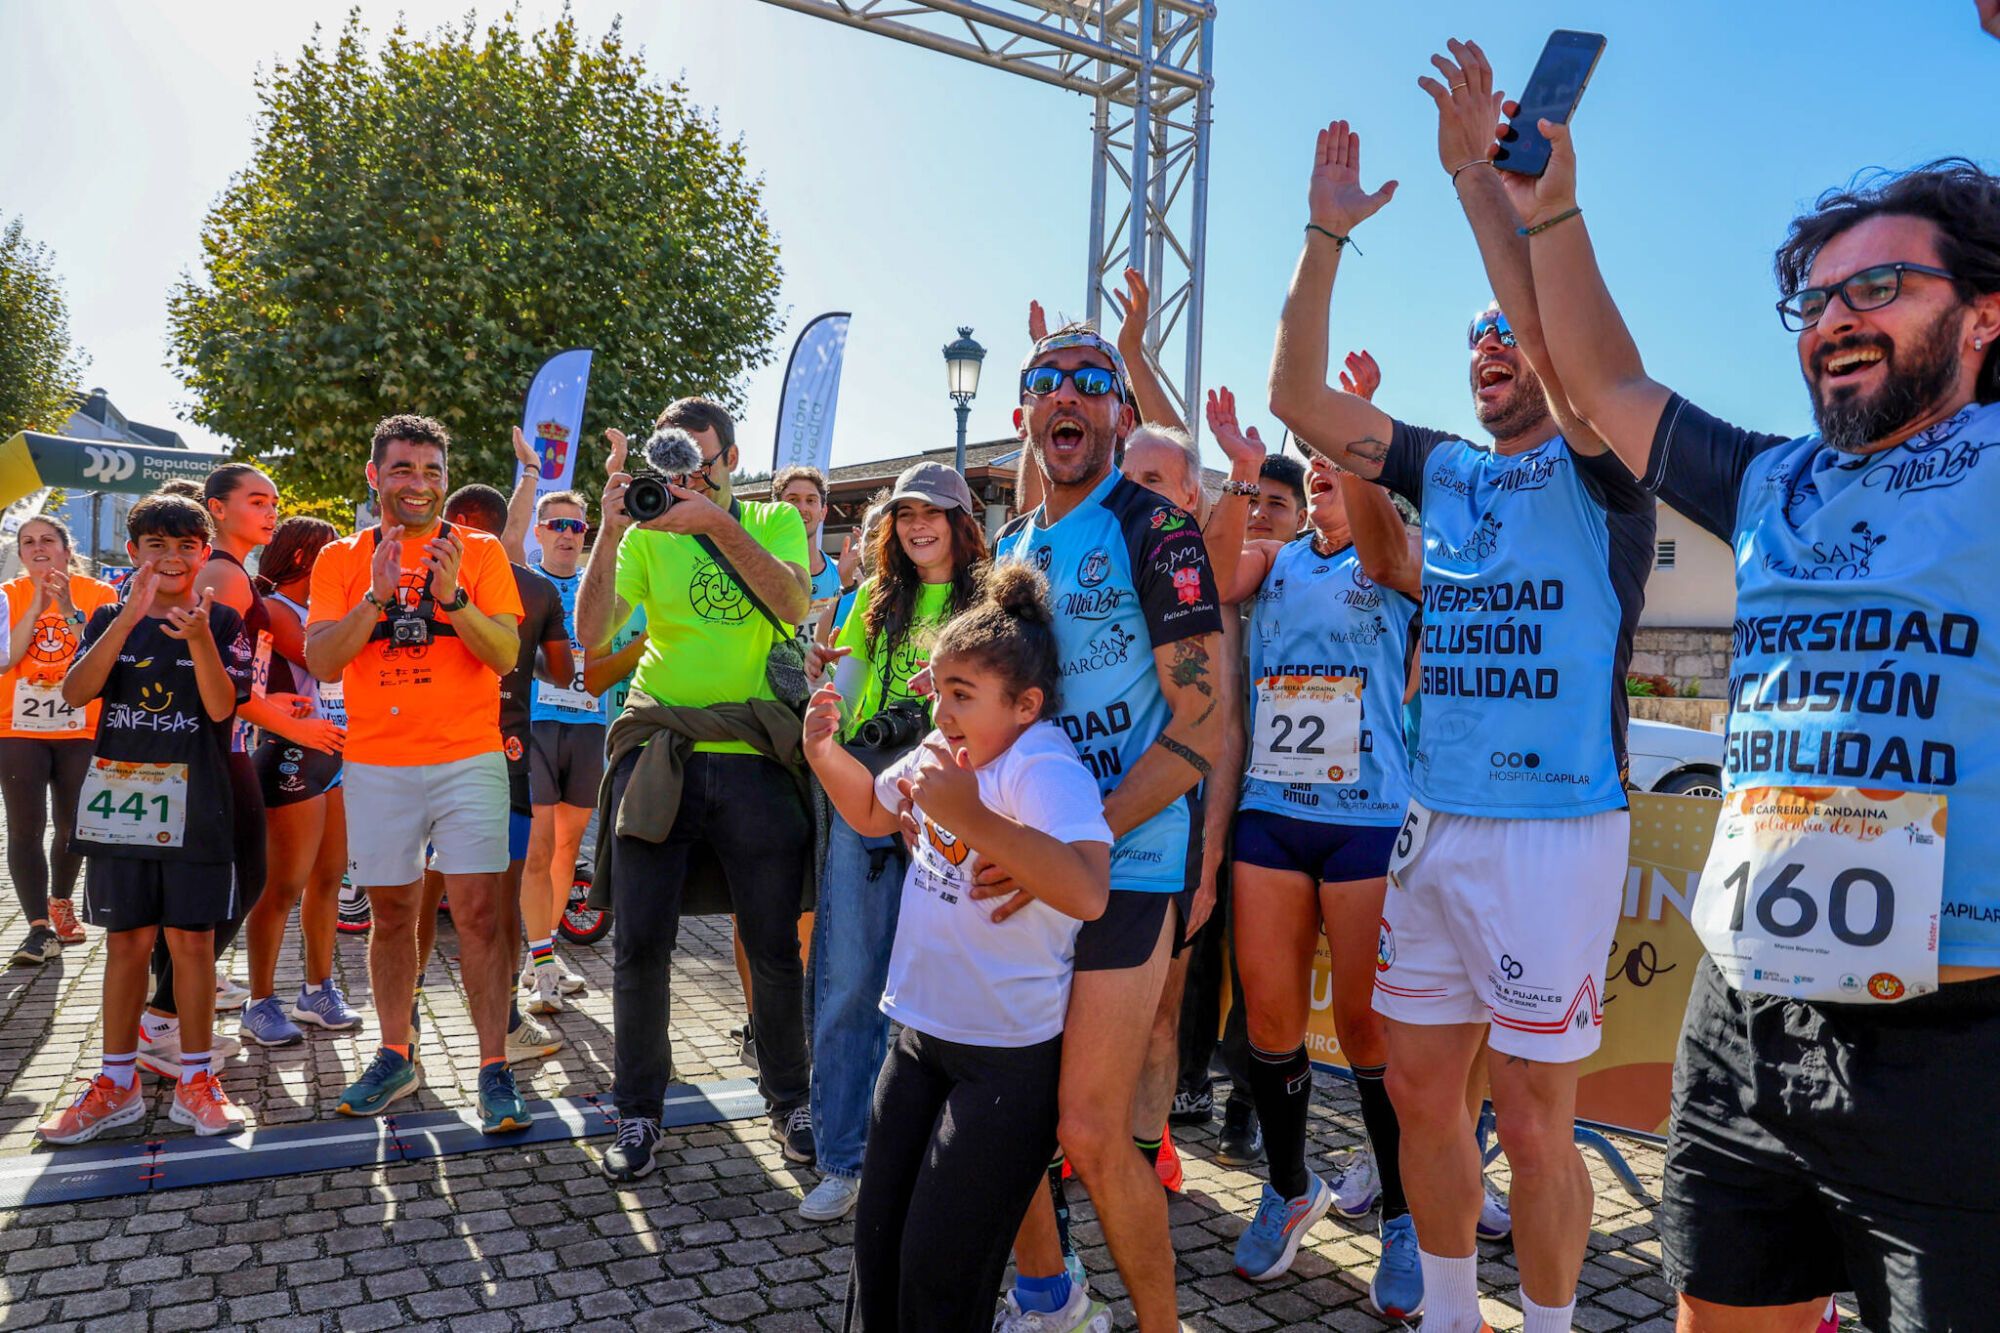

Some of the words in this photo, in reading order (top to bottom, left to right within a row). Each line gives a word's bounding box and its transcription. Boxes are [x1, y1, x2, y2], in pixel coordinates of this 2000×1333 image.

[1812, 541, 1869, 564] SAN
[1090, 638, 1125, 655] SAN
[1330, 632, 1378, 645] MARCOS
[22, 698, 75, 718] 214
[106, 707, 200, 733] SONRISAS
[1270, 714, 1325, 754] 22
[87, 790, 168, 823] 441
[1283, 790, 1319, 806] PITILLO
[1756, 805, 1810, 816] CARREIRA
[1814, 807, 1820, 815] E
[1824, 806, 1888, 819] ANDAINA
[1858, 818, 1887, 842] Leo
[1723, 861, 1895, 948] 160
[1512, 989, 1563, 1003] PUJALES
